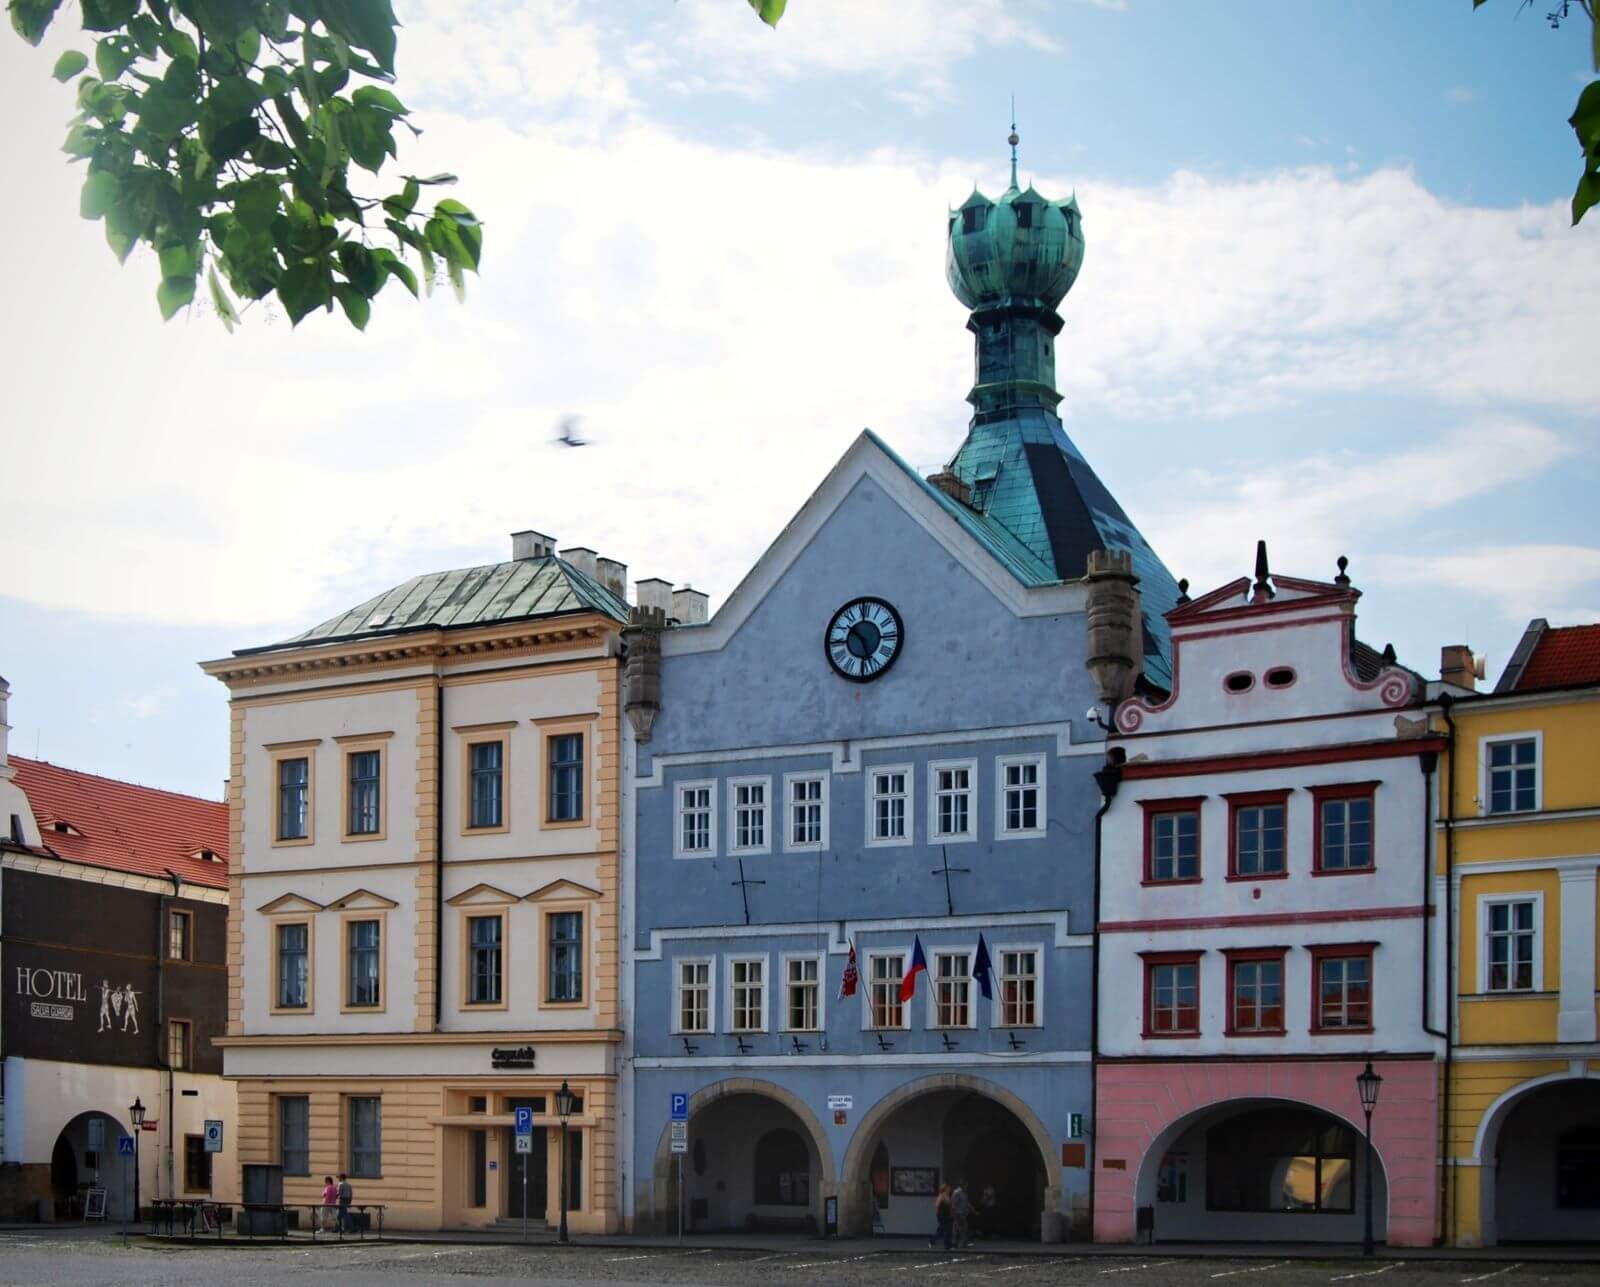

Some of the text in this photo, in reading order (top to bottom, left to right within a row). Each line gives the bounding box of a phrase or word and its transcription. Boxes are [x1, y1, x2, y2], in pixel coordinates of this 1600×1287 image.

[16, 966, 86, 1001] HOTEL
[674, 1095, 685, 1112] P
[519, 1110, 529, 1126] P
